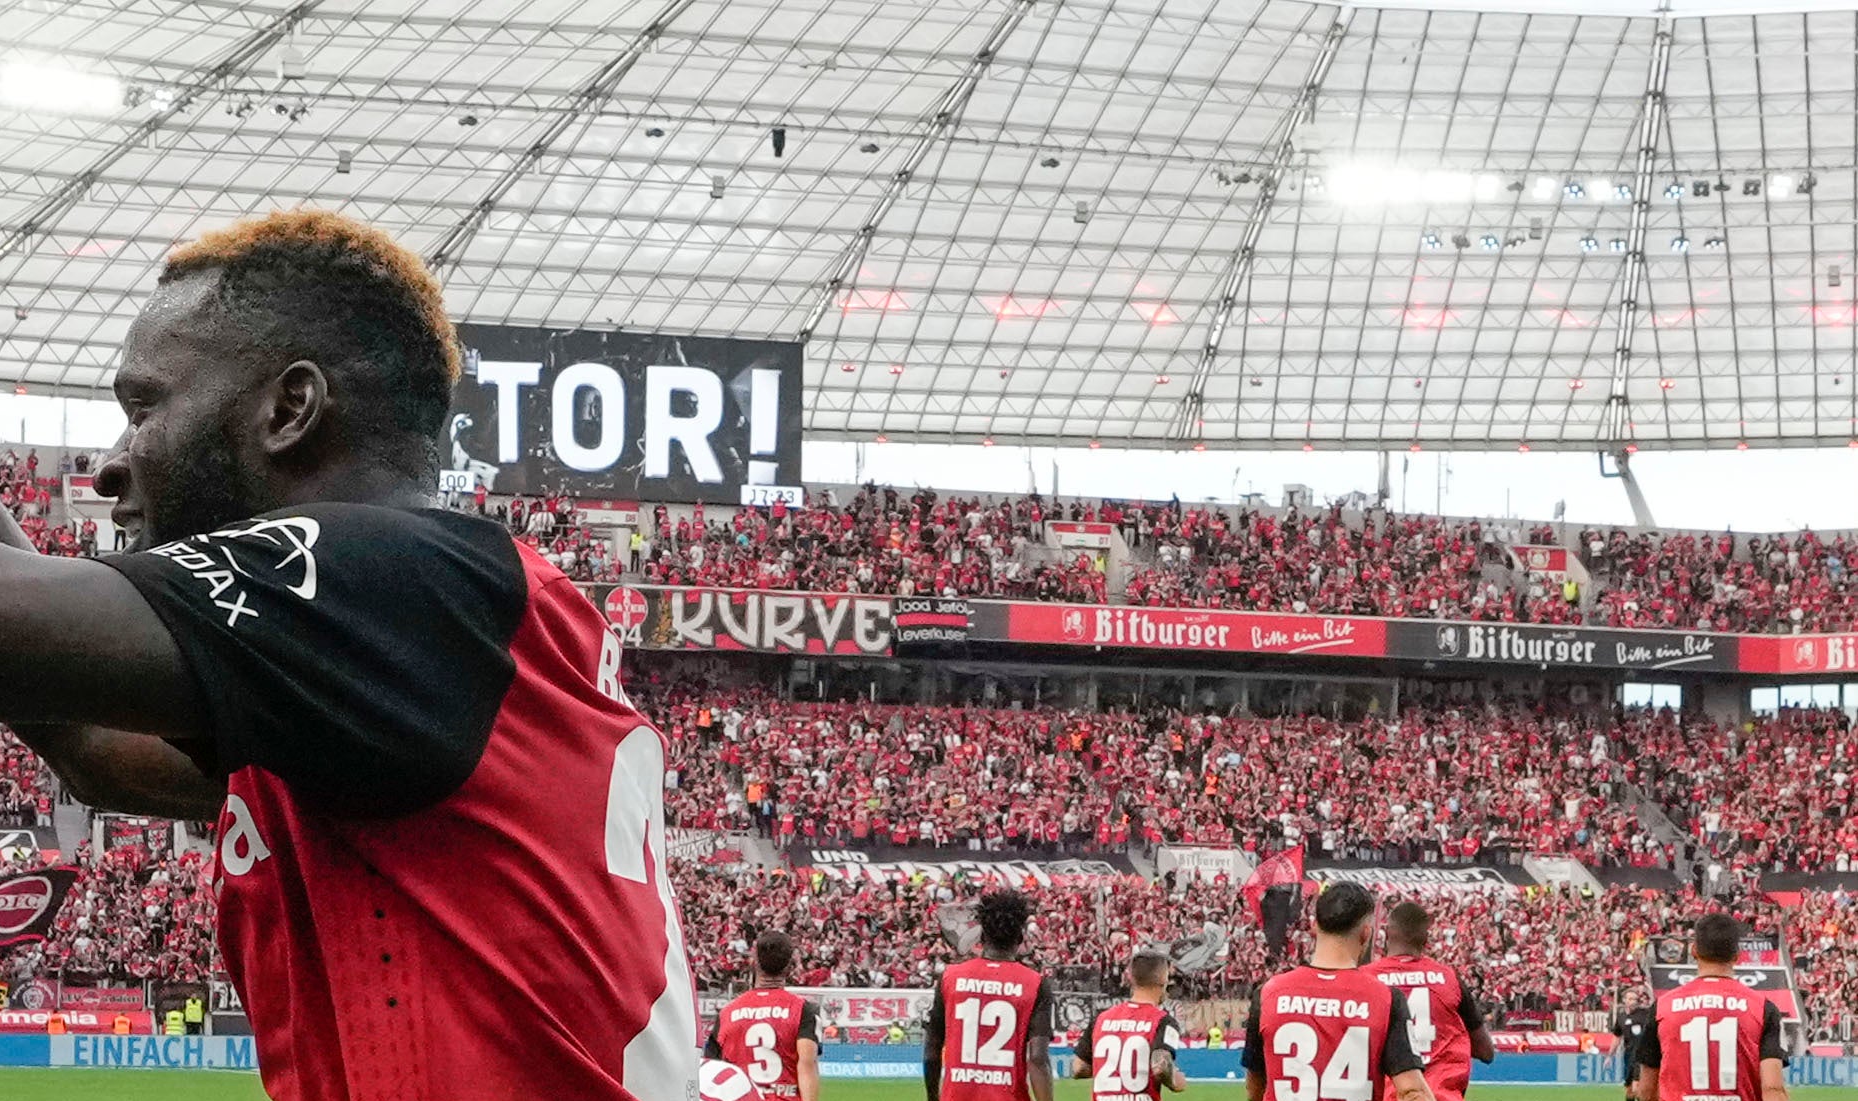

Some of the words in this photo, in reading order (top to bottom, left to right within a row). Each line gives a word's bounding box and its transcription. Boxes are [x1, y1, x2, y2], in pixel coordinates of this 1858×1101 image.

[477, 361, 783, 486] TOR!
[146, 542, 259, 627] EDAX
[607, 601, 647, 613] BAYER
[671, 592, 892, 651] KURVE
[1094, 609, 1230, 648] Bitburger
[1251, 626, 1289, 648] Bitte
[1293, 629, 1321, 643] ein
[1323, 619, 1355, 639] Bit
[1467, 626, 1597, 663] Bitburger
[1616, 644, 1654, 665] Bitte
[1655, 644, 1683, 658] ein
[1684, 635, 1715, 656] Bit
[1826, 637, 1858, 670] Bi
[811, 850, 869, 864] UND
[955, 978, 1003, 995] BAYER
[1004, 982, 1023, 996] 04
[1377, 971, 1425, 986] BAYER
[1427, 972, 1445, 984] 04
[730, 1006, 771, 1022] BAYER
[772, 1006, 790, 1020] 04
[848, 998, 911, 1020] FSI
[1276, 996, 1341, 1017] BAYER
[1343, 1000, 1370, 1019] 04
[1671, 994, 1724, 1012] BAYER
[1726, 997, 1748, 1011] 04
[954, 998, 1017, 1067] 12
[1101, 1020, 1136, 1033] BAYER
[1136, 1021, 1152, 1033] 04
[74, 1036, 214, 1067] EINFACH.
[745, 1022, 783, 1083] 3
[1094, 1035, 1151, 1093] 20
[1680, 1016, 1738, 1090] 11
[865, 1062, 920, 1078] NIEDAX
[950, 1068, 1013, 1086] TAPSOBA
